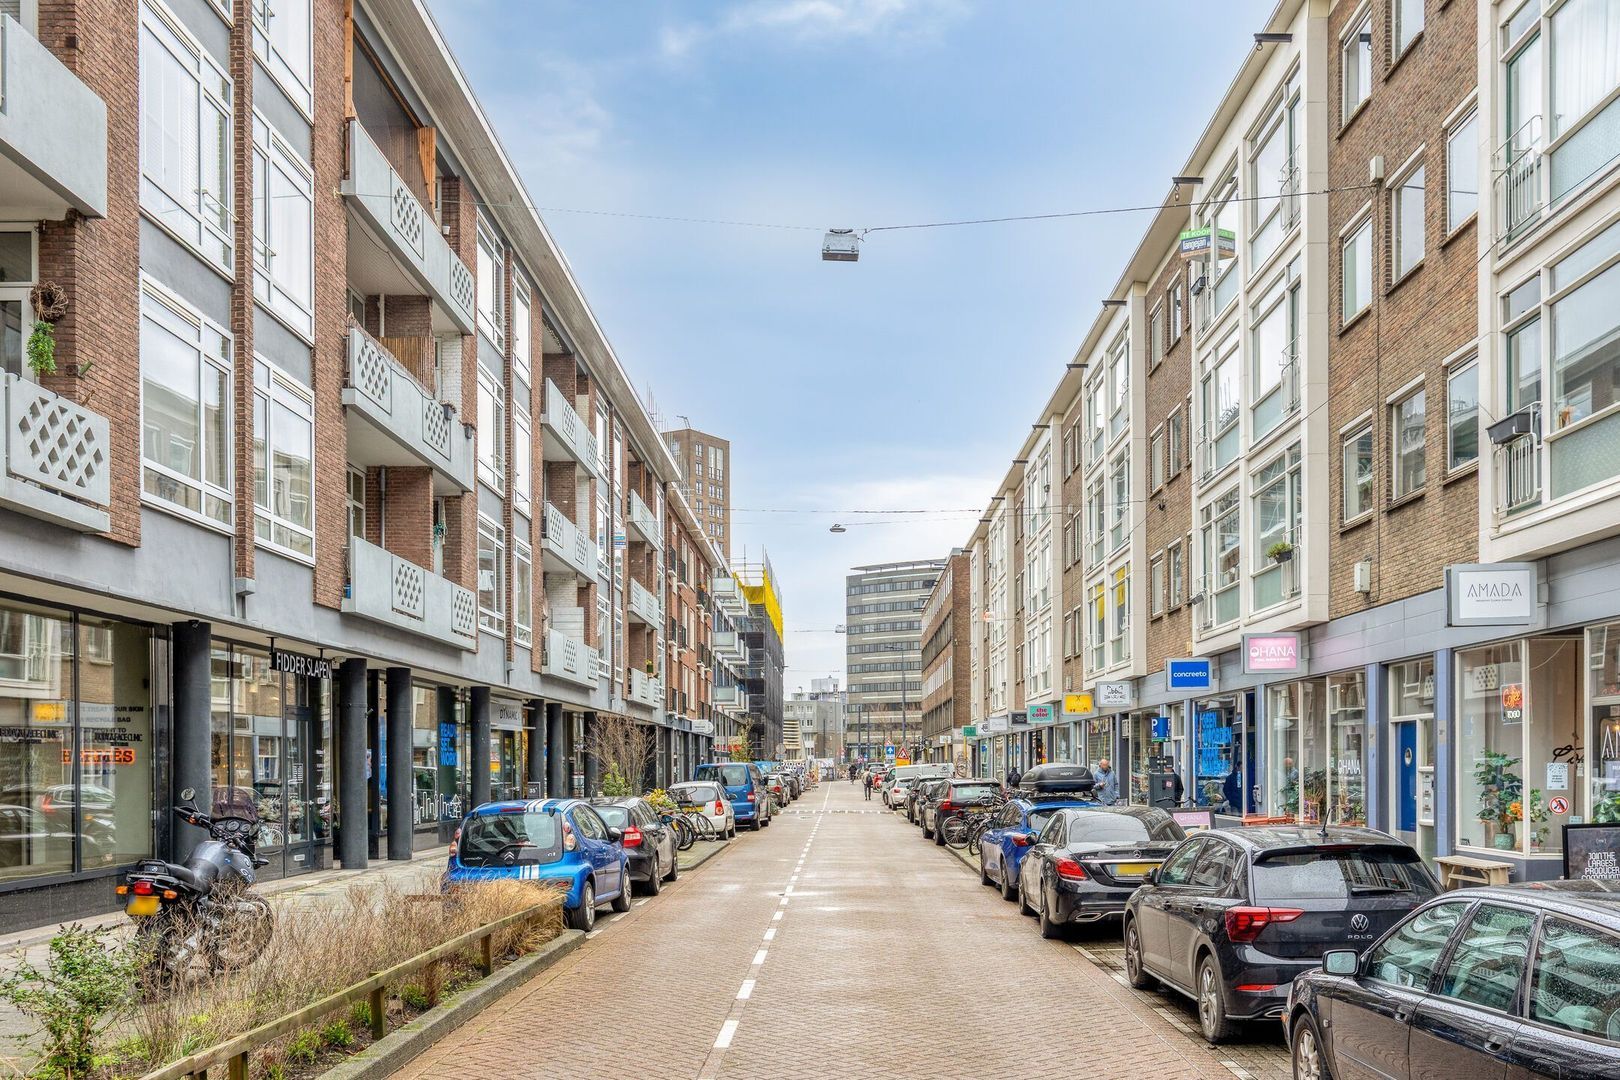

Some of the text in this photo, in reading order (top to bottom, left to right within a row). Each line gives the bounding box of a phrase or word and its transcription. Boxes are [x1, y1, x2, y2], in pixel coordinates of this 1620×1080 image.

[1467, 583, 1522, 597] AMADA
[1250, 646, 1297, 657] OHANA
[276, 652, 333, 679] FIDDER SLAPEN
[1338, 760, 1361, 774] OHANA
